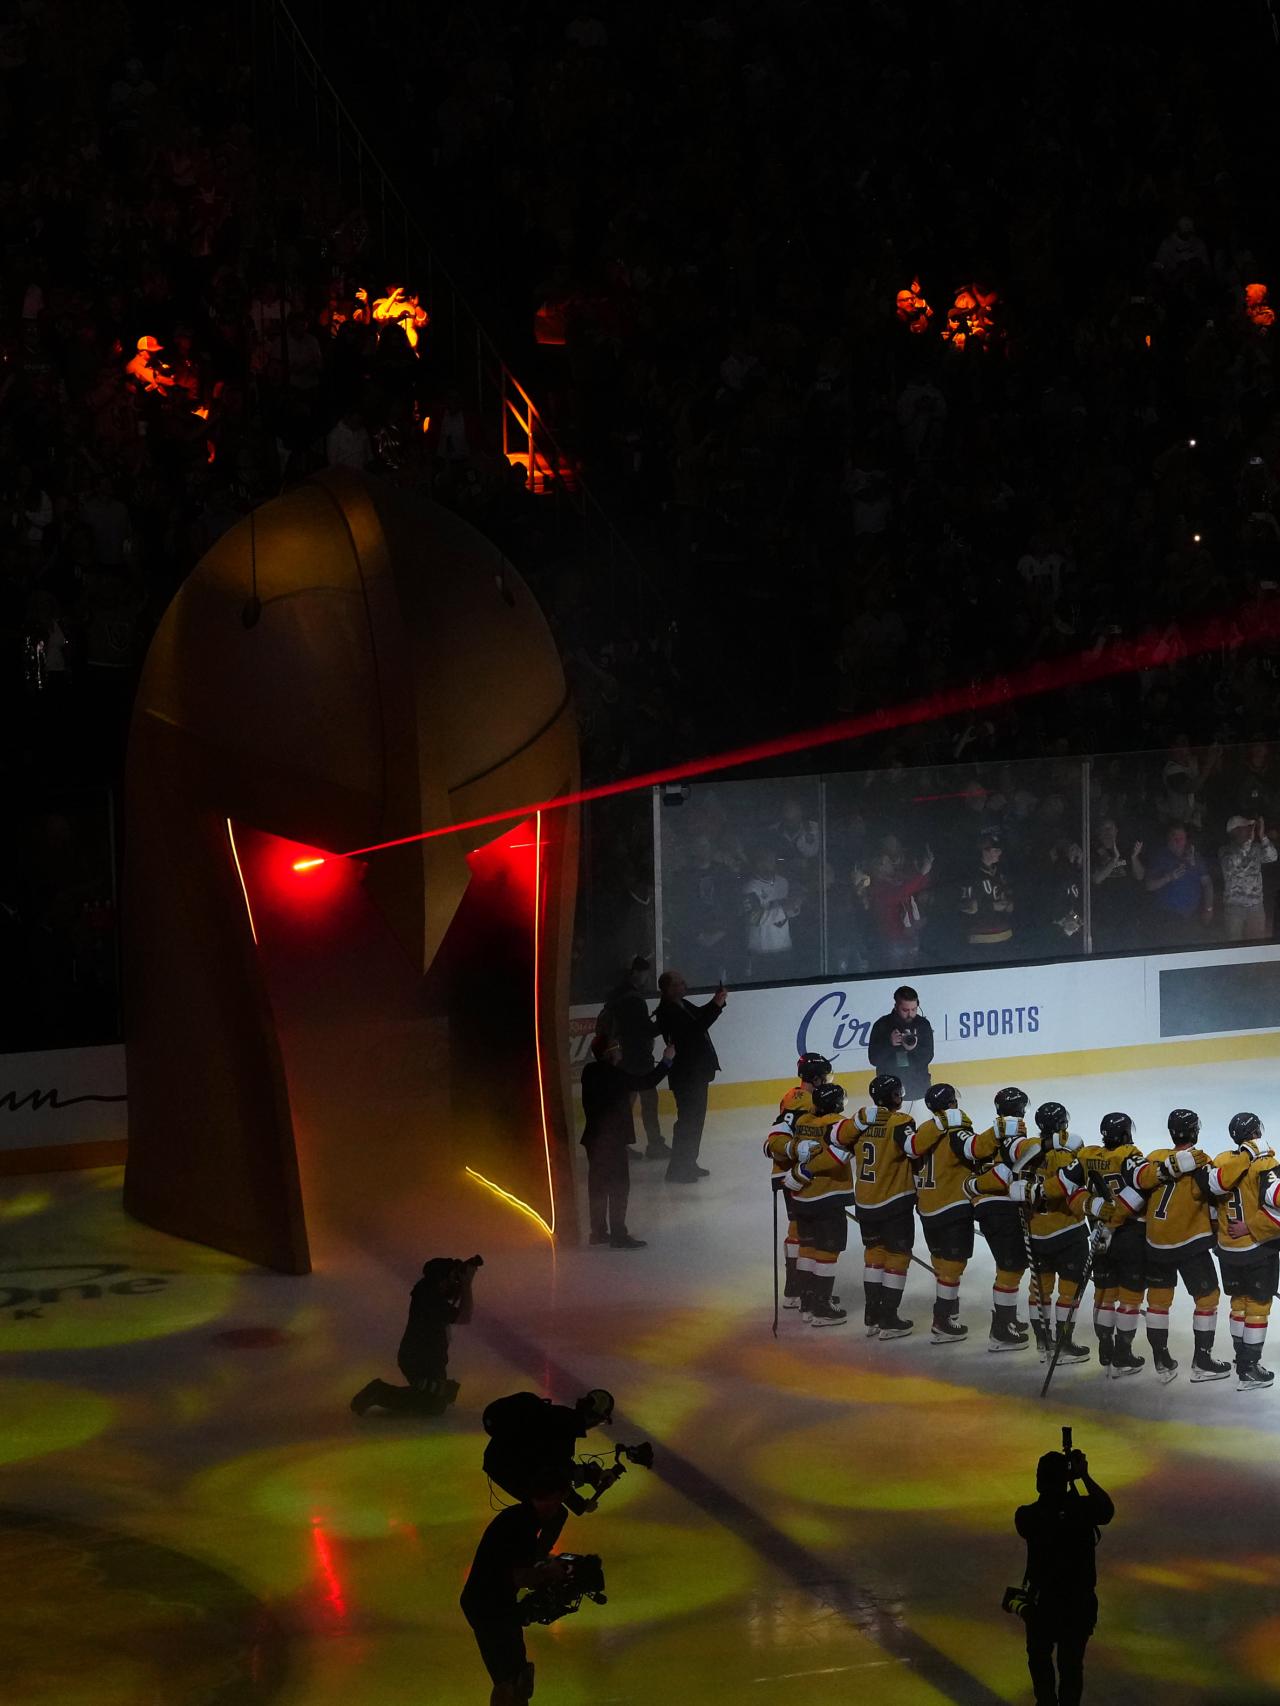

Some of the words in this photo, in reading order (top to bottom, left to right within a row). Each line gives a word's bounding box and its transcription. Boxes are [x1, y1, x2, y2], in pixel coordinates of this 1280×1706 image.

[797, 991, 871, 1063] Cir
[959, 1006, 1040, 1039] SPORTS
[861, 1142, 876, 1183] 2
